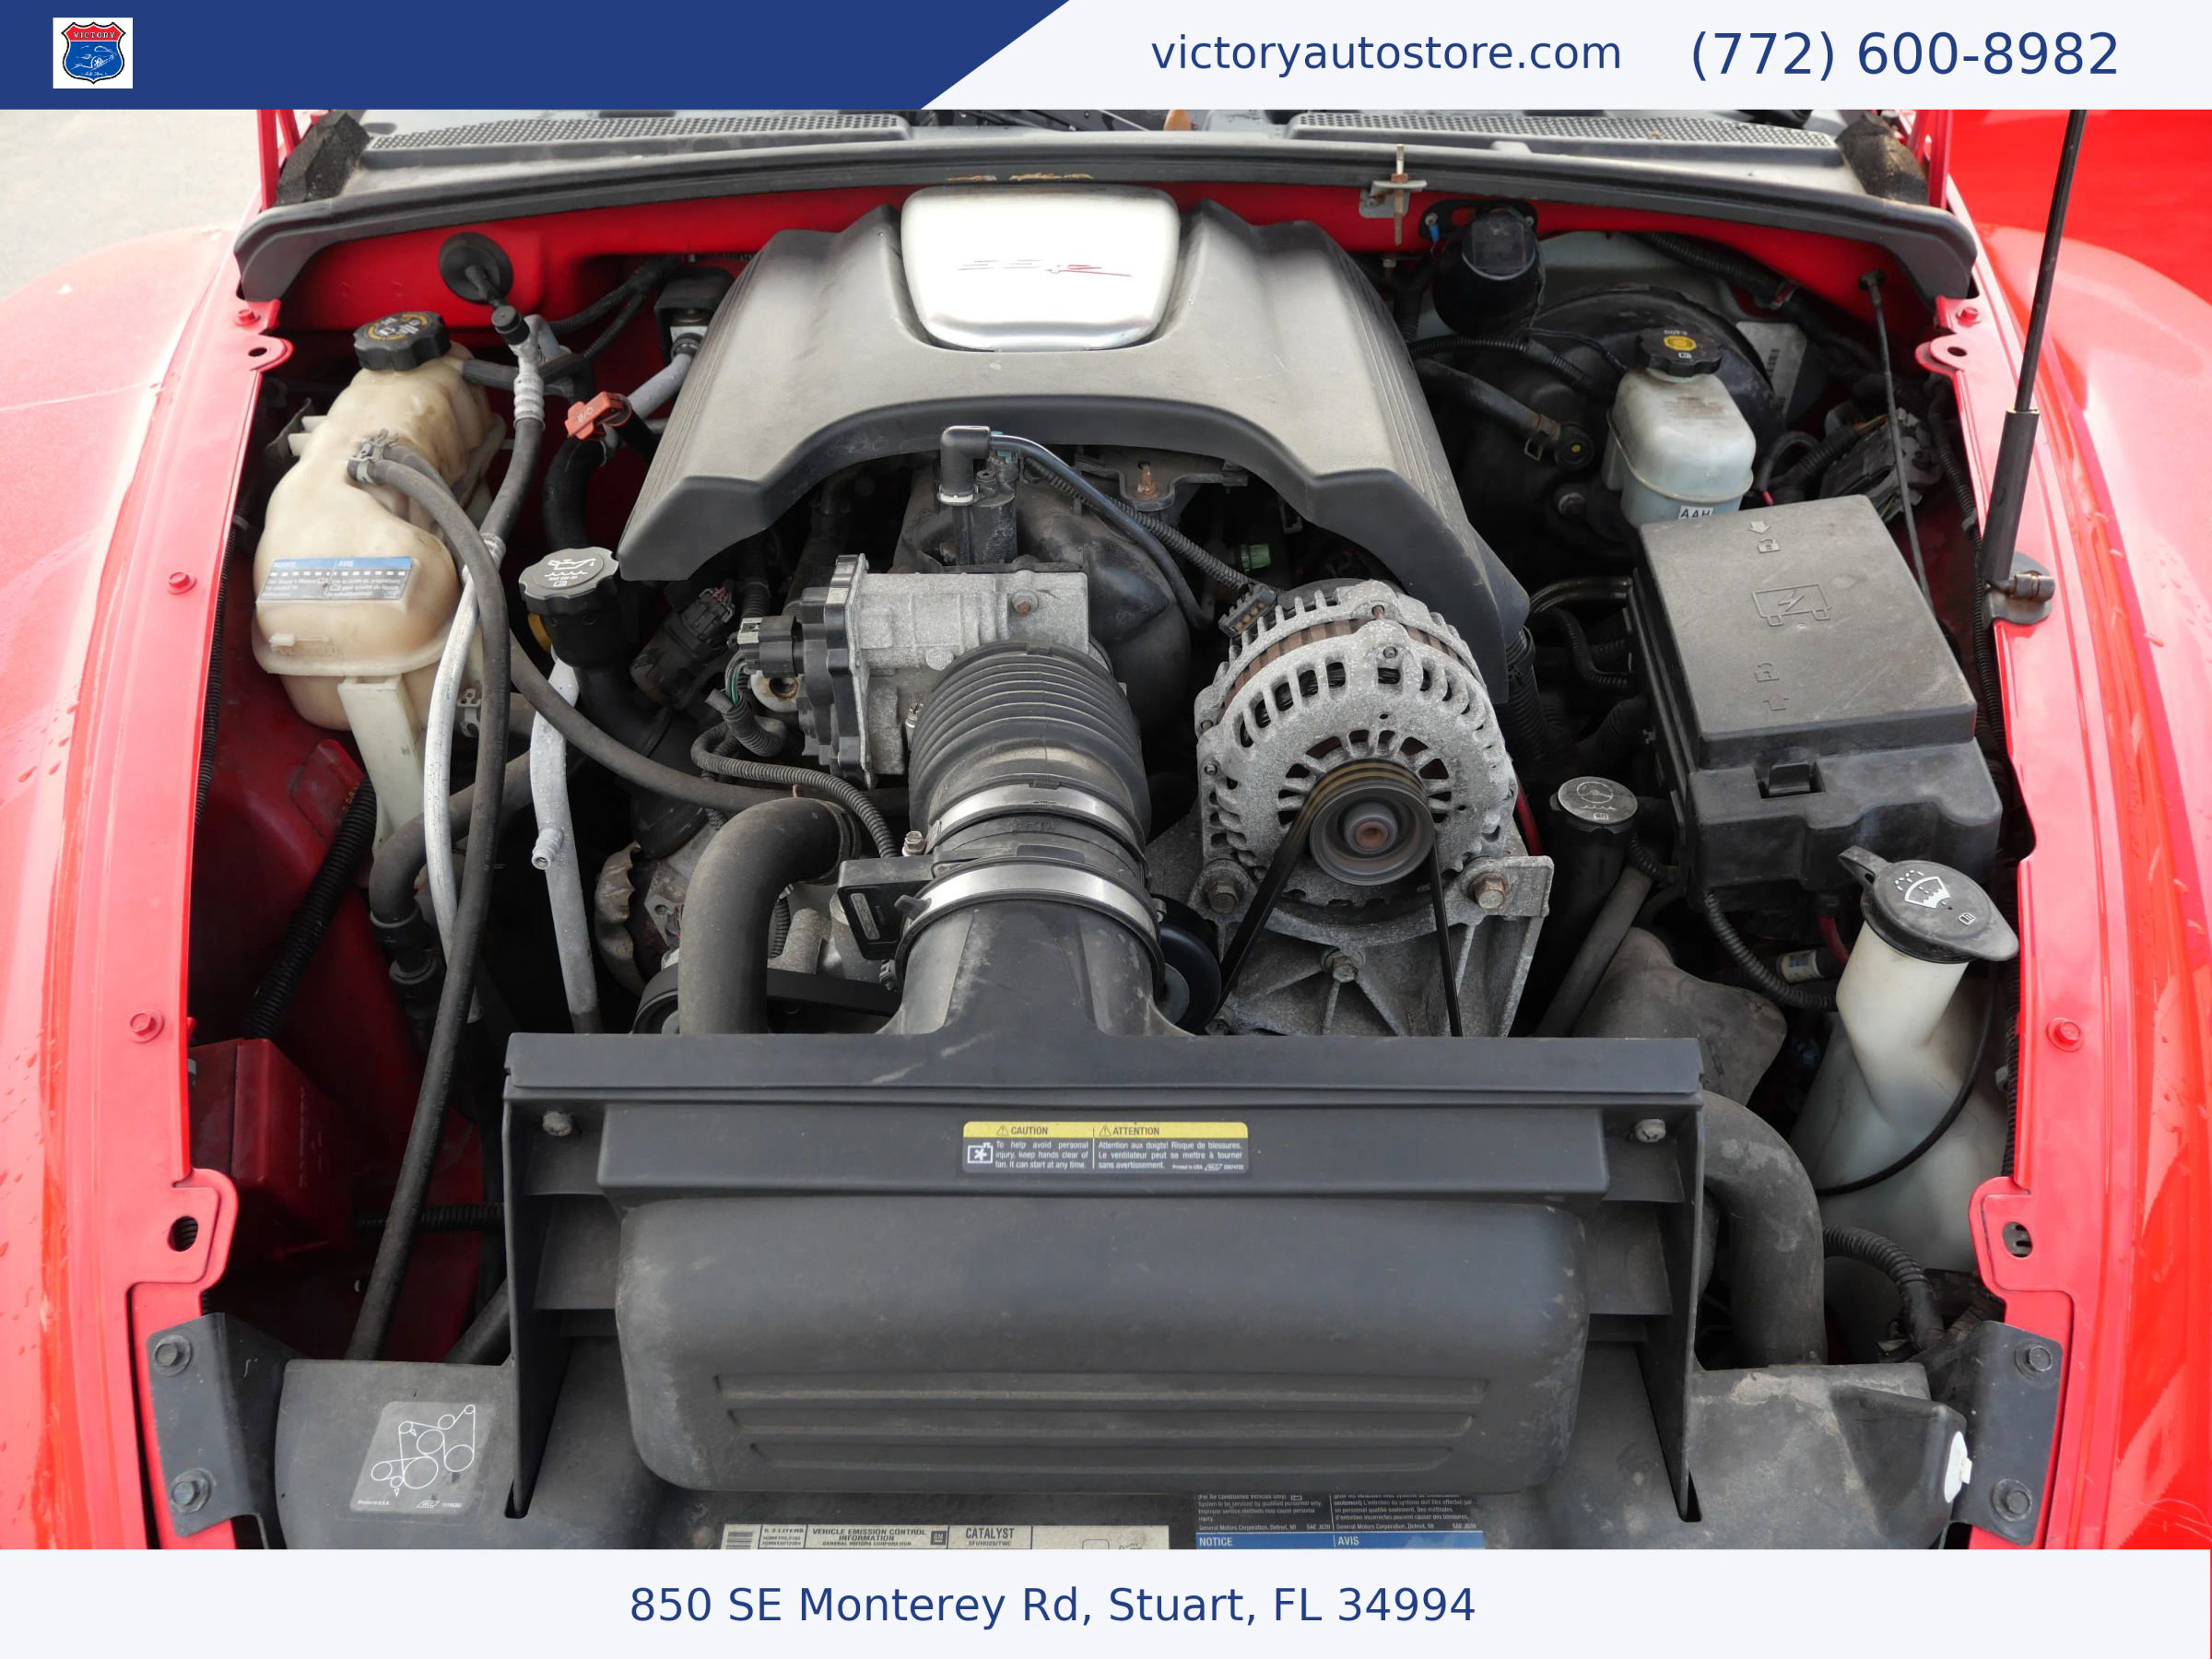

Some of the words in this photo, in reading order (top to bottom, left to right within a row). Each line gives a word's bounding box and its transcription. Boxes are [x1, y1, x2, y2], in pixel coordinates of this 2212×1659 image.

[1011, 1126, 1048, 1135] CAUTION
[1112, 1126, 1159, 1135] ATTENTION
[1010, 1141, 1027, 1150] help
[1033, 1141, 1052, 1149] avoid
[1058, 1141, 1088, 1150] personal
[1098, 1141, 1128, 1149] Attention
[1131, 1141, 1143, 1149] aux
[1171, 1141, 1194, 1150] Risque
[1197, 1141, 1206, 1149] de
[1018, 1151, 1036, 1159] keep
[1055, 1161, 1067, 1170] any
[965, 1527, 1015, 1539] CATALYST
[1198, 1536, 1233, 1547] NOTICE
[1337, 1535, 1360, 1546] AVIS
